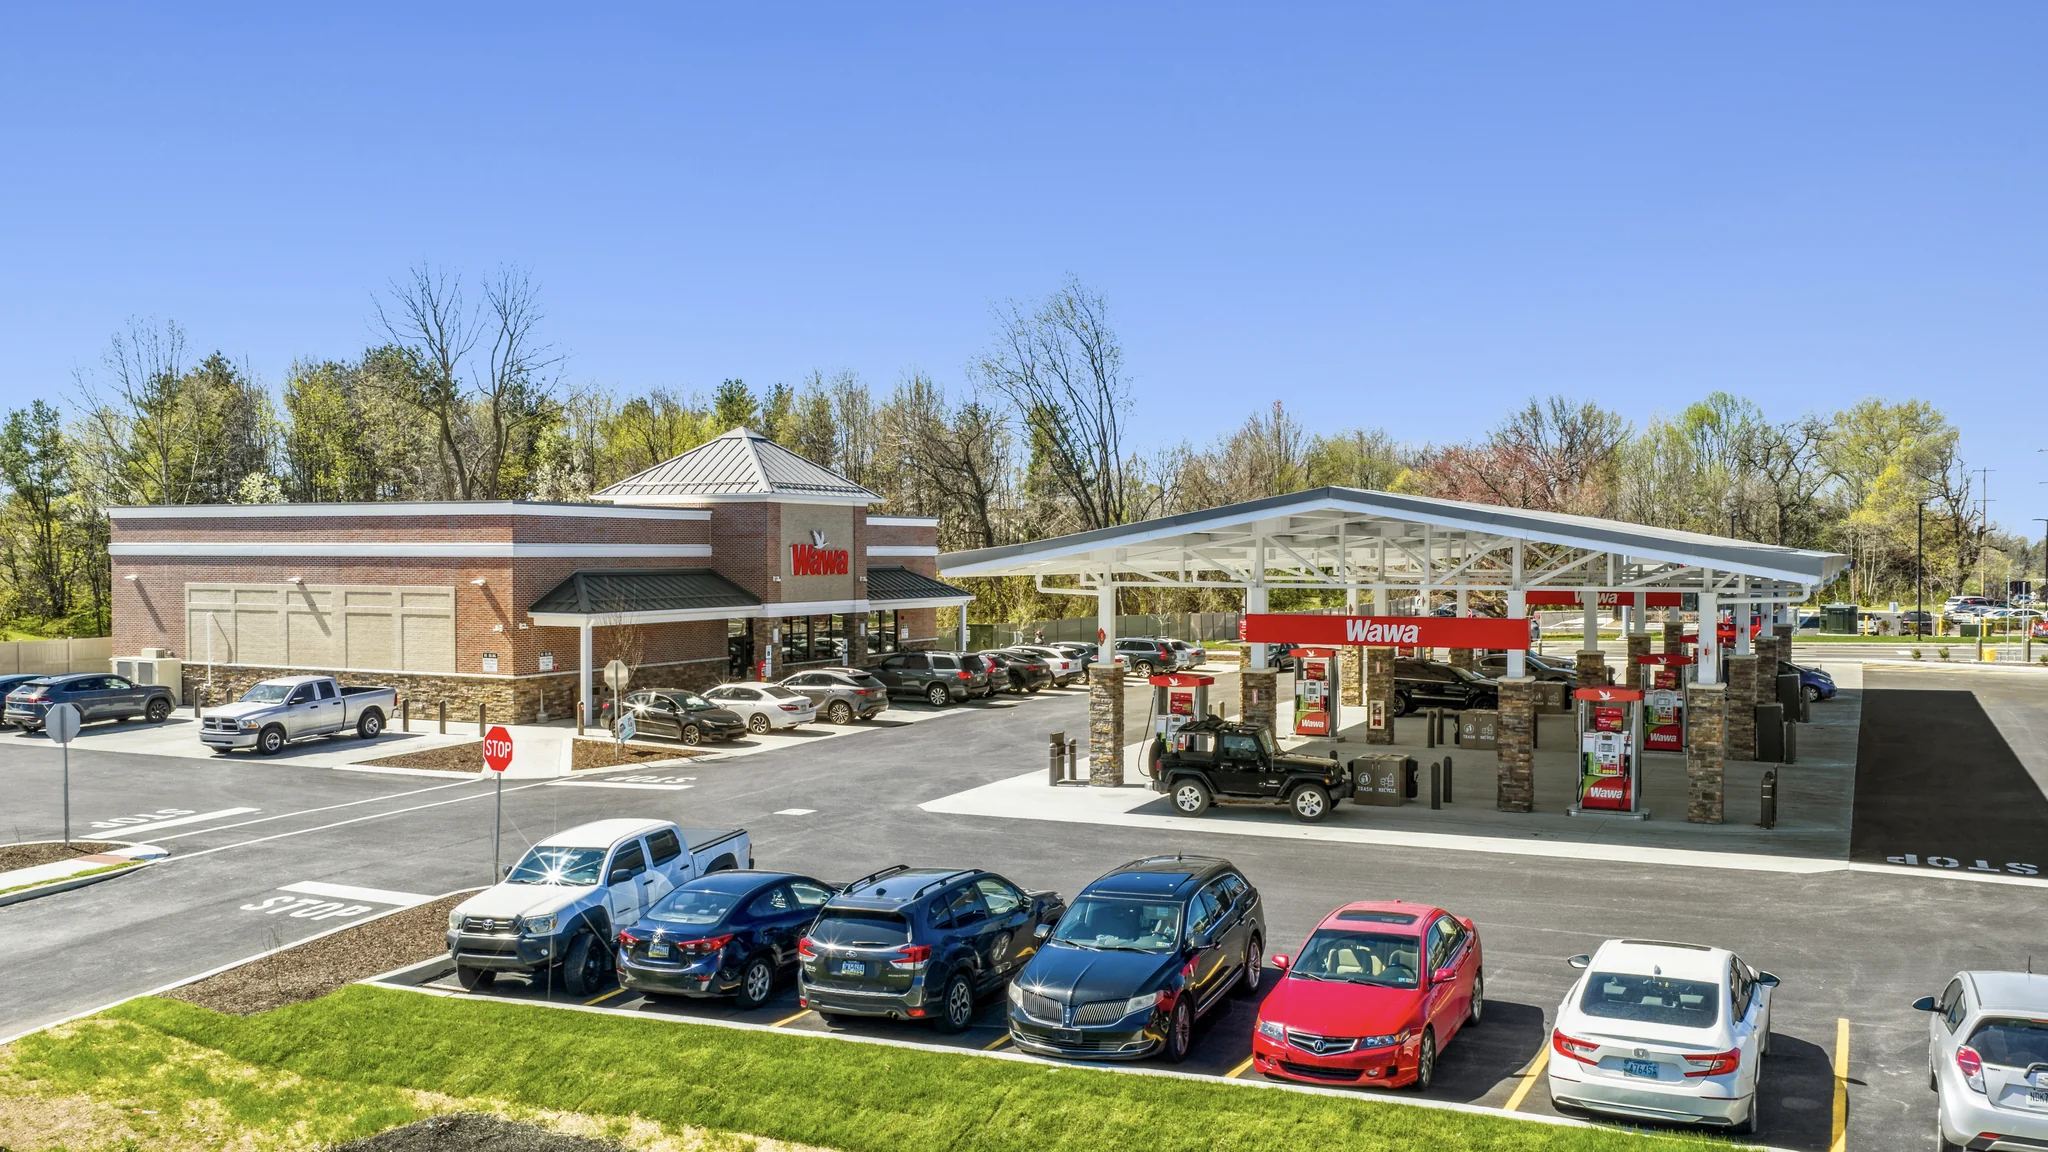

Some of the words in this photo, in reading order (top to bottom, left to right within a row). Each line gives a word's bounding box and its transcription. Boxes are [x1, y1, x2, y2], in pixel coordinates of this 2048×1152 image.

[790, 544, 848, 576] Wawa
[1574, 591, 1618, 604] Wwa
[1346, 619, 1419, 643] Wawa
[1302, 719, 1324, 728] Wawa
[1650, 732, 1677, 742] Wawa
[485, 739, 512, 758] STOP
[1590, 786, 1623, 799] Wawa
[91, 808, 196, 829] STOP
[1886, 853, 2039, 875] STOP
[239, 895, 373, 921] STOP
